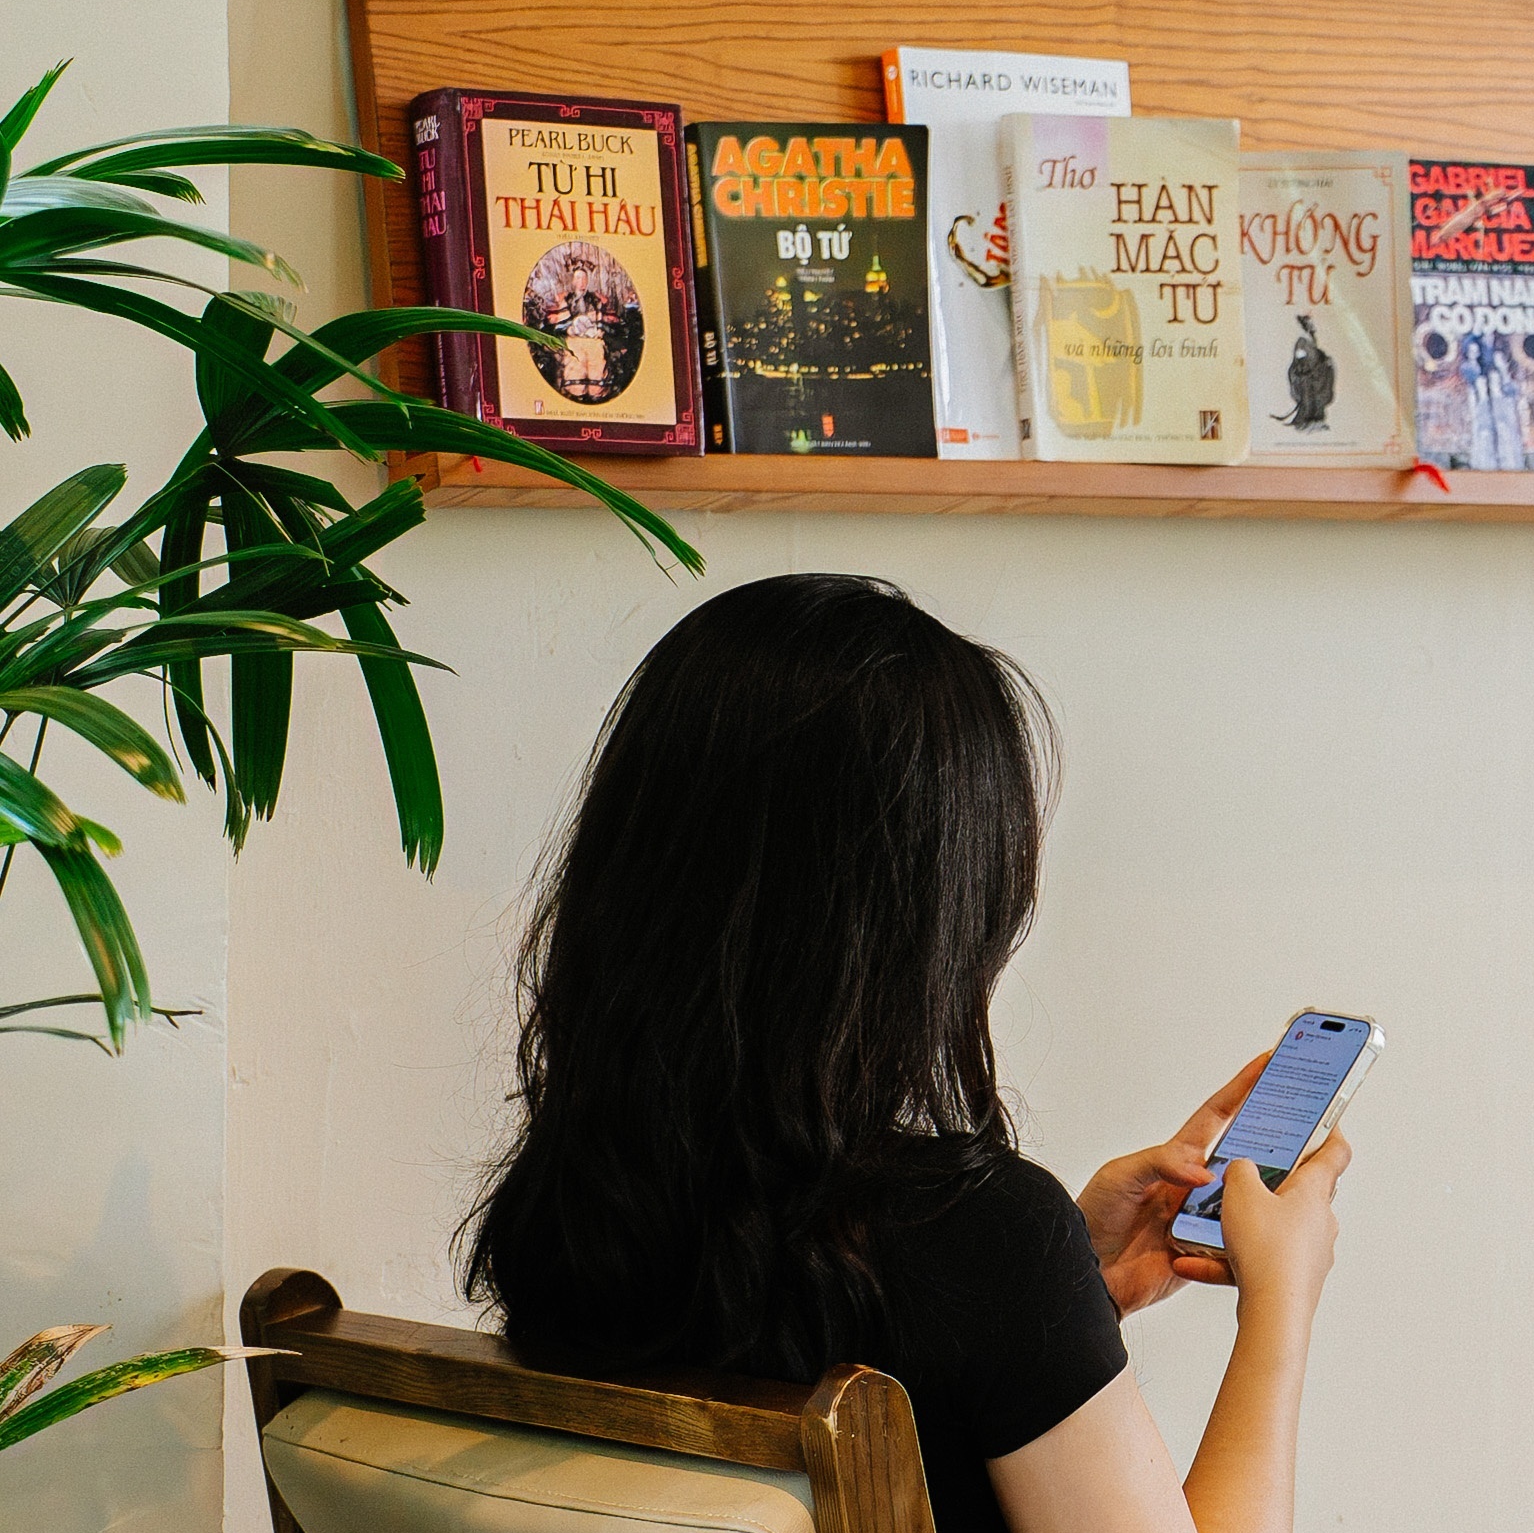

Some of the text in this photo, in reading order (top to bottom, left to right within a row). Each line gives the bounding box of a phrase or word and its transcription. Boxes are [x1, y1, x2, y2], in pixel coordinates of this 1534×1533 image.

[910, 69, 1118, 98] RICHARD WISEMAN
[508, 127, 634, 155] PEARL BUCK
[711, 134, 914, 177] AGATHA
[528, 160, 619, 198] TỪ HI
[1039, 155, 1097, 190] Thơ
[495, 195, 657, 237] THÁI HẬU
[711, 176, 916, 219] CHRISTIE
[776, 223, 813, 266] BỘ
